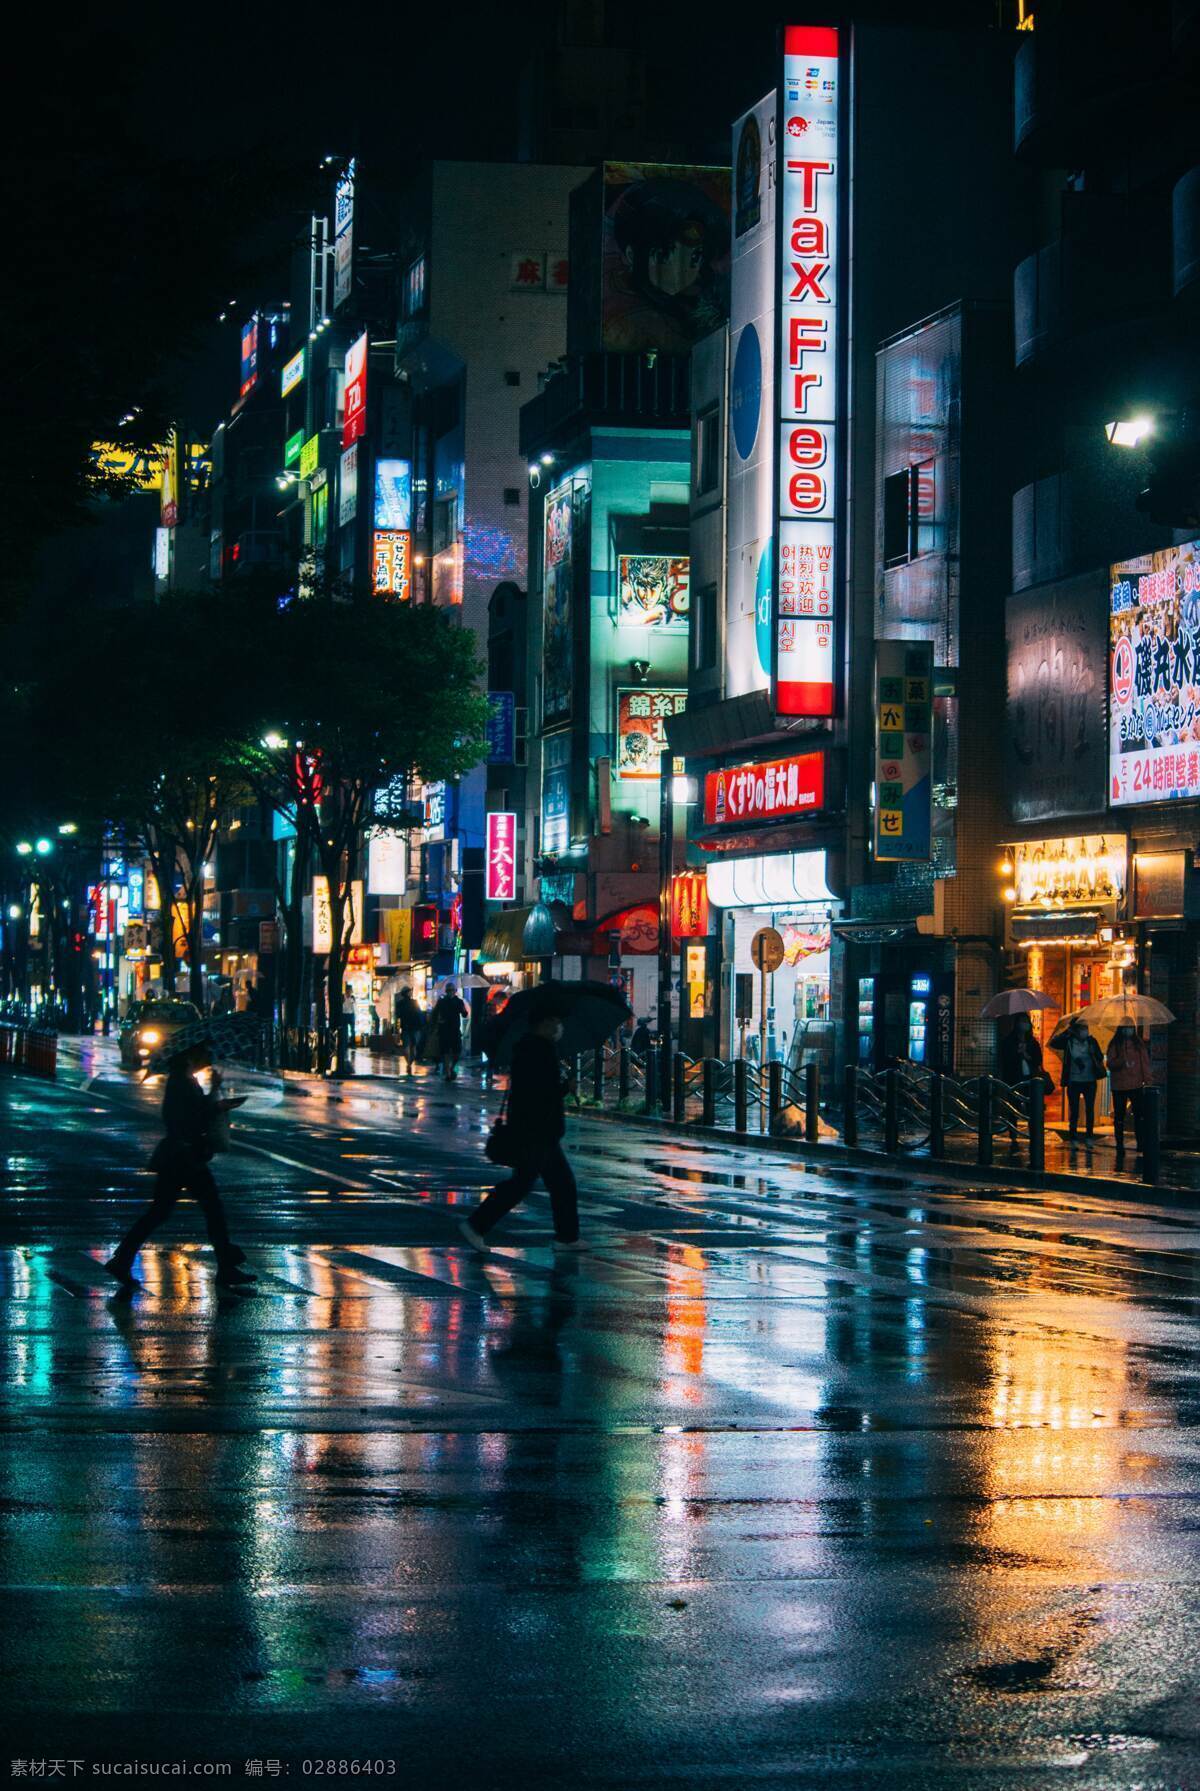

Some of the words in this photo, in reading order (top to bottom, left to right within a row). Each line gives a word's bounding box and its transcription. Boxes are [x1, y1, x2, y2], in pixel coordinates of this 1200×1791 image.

[787, 160, 834, 303] Tax
[788, 317, 827, 514] Free
[799, 545, 815, 613] 热烈欢迎
[817, 545, 832, 647] Welcome
[728, 763, 799, 815] くすりの福太郎
